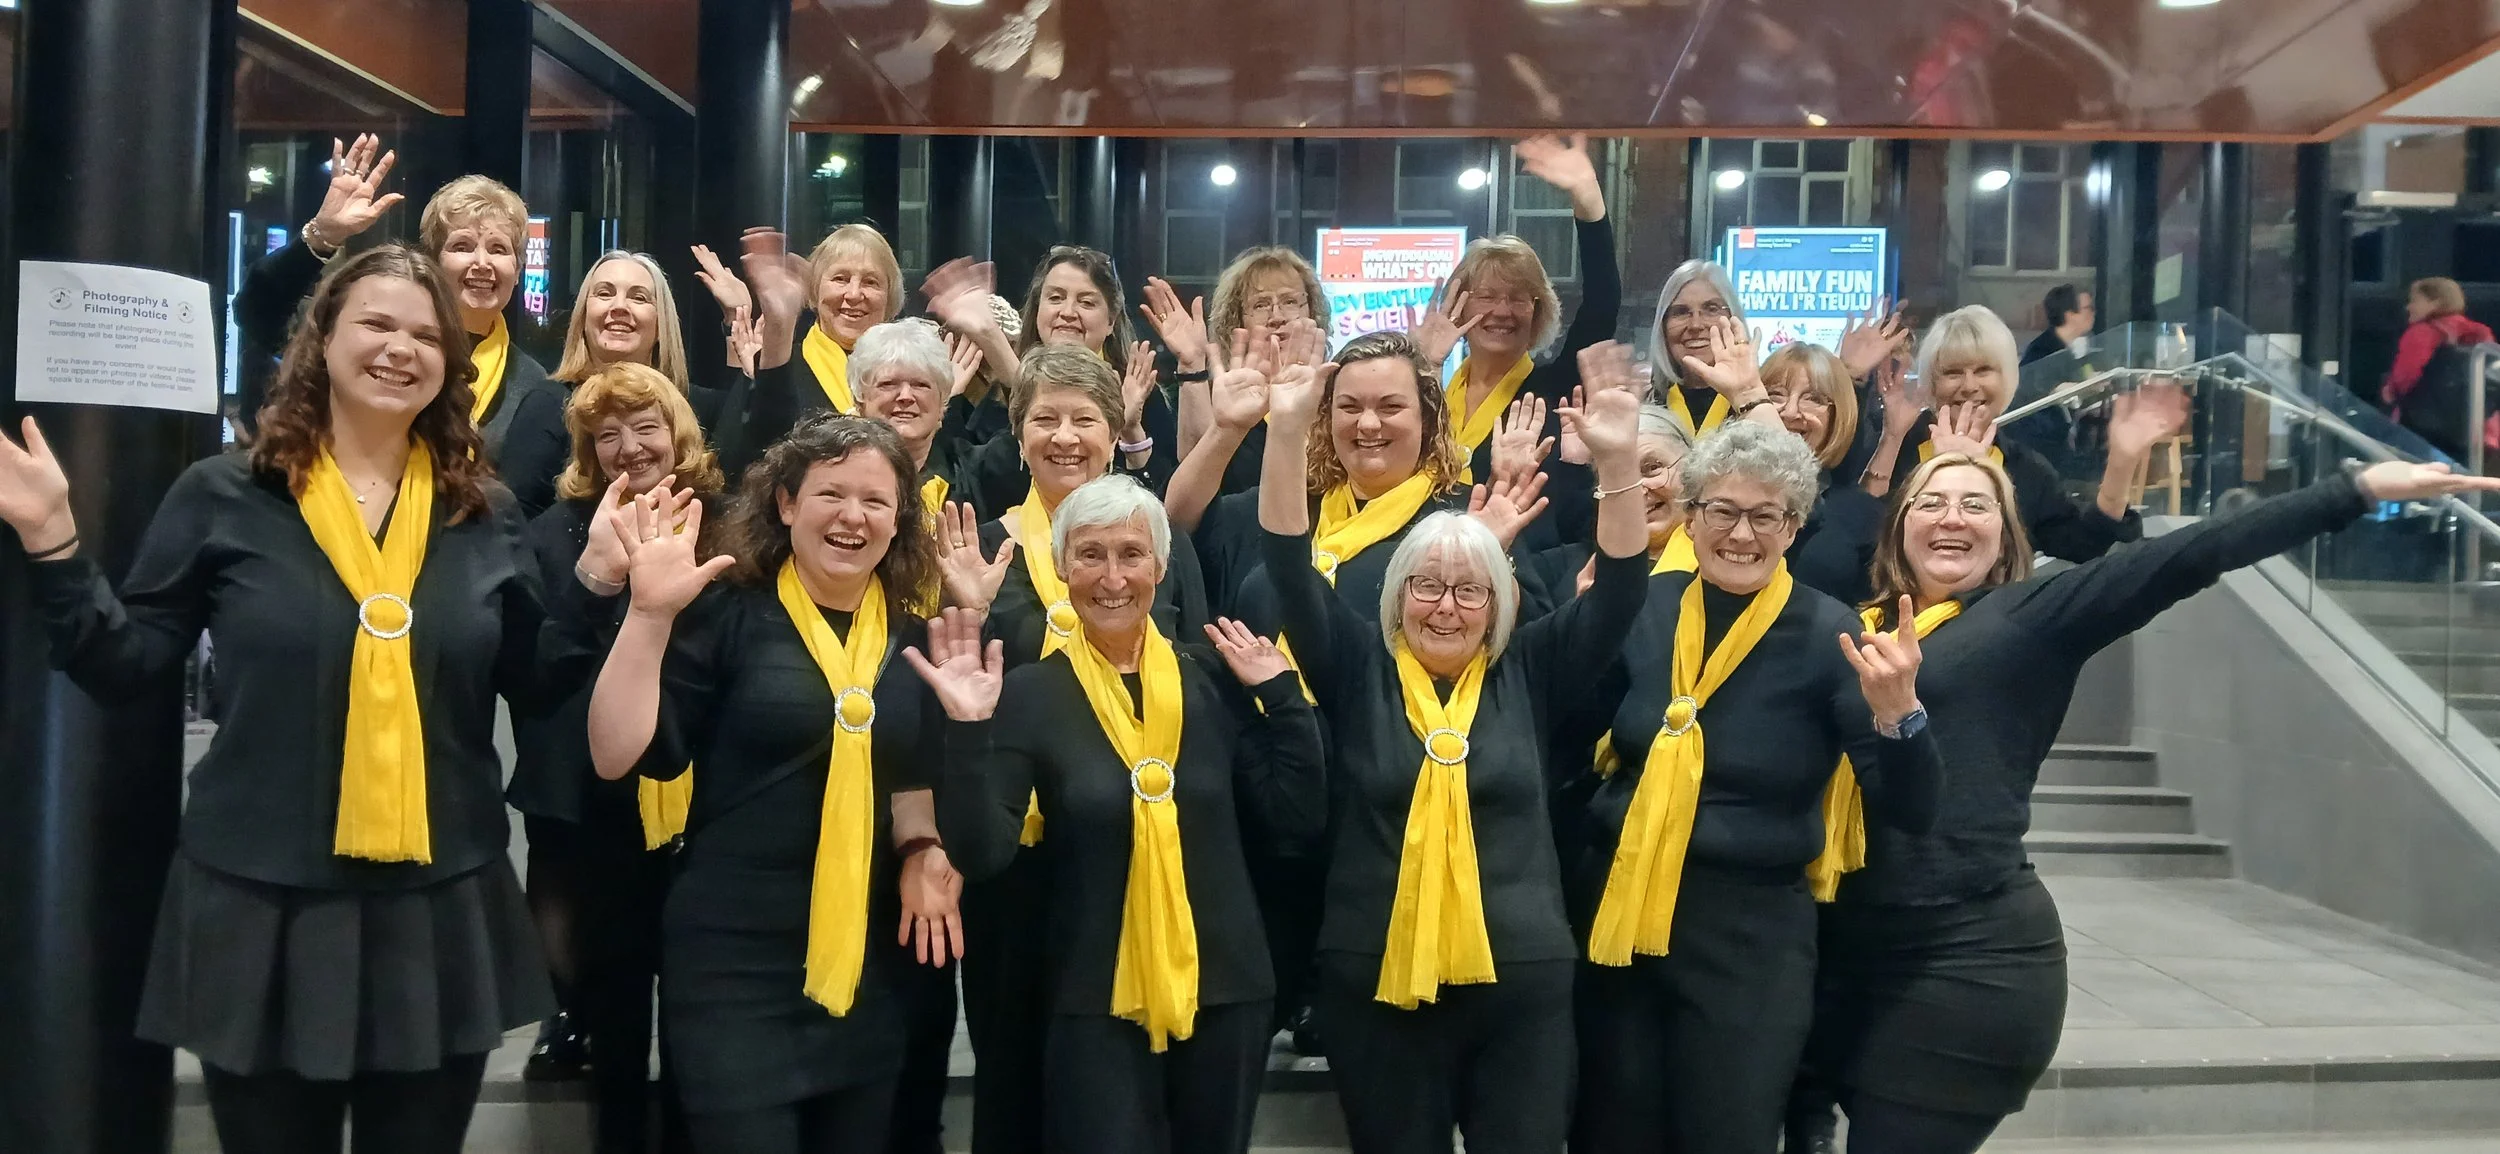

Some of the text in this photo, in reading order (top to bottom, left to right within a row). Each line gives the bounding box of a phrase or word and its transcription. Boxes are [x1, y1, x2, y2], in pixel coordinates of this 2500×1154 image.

[1361, 262, 1454, 279] WHAT'S ON
[1738, 269, 1873, 293] FAMILY FUN
[83, 290, 158, 308] Photography
[161, 298, 169, 307] &
[1739, 292, 1872, 311] HWYL I'R TEULU
[84, 303, 129, 318] Filming
[132, 307, 168, 321] Notice
[49, 319, 77, 328] Please
[78, 321, 96, 329] note
[98, 322, 113, 330] that
[115, 323, 162, 335] photography
[48, 329, 85, 339] recording
[87, 330, 101, 338] will
[102, 331, 113, 339] be
[115, 333, 139, 343] taking
[141, 334, 160, 344] place
[53, 358, 69, 366] you
[70, 357, 90, 366] have
[92, 360, 107, 369] any
[109, 360, 145, 369] concerns
[46, 366, 59, 374] not
[70, 368, 99, 377] appear
[110, 369, 137, 379] photos
[48, 375, 72, 385] speak
[92, 378, 125, 386] member
[136, 380, 149, 388] the
